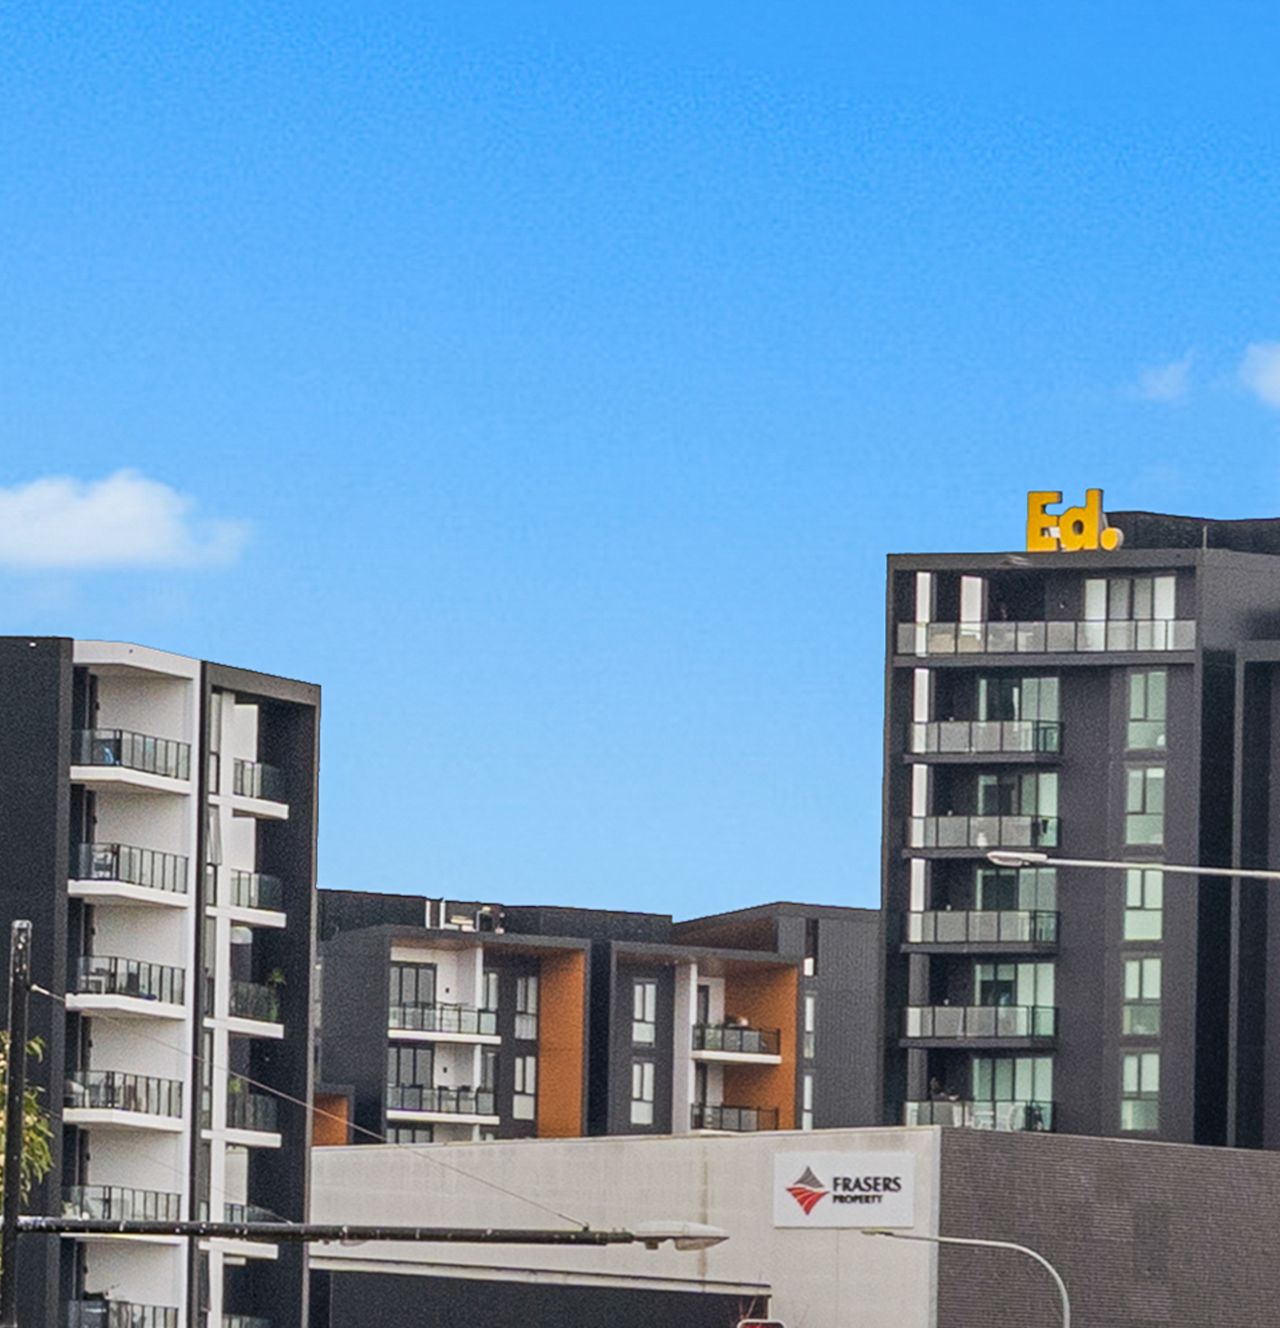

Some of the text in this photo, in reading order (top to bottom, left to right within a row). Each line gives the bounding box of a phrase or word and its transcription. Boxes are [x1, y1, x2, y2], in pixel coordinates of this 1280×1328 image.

[1026, 489, 1122, 553] Ed.
[832, 1177, 901, 1192] FRASERS
[832, 1195, 883, 1204] PROPERTY
